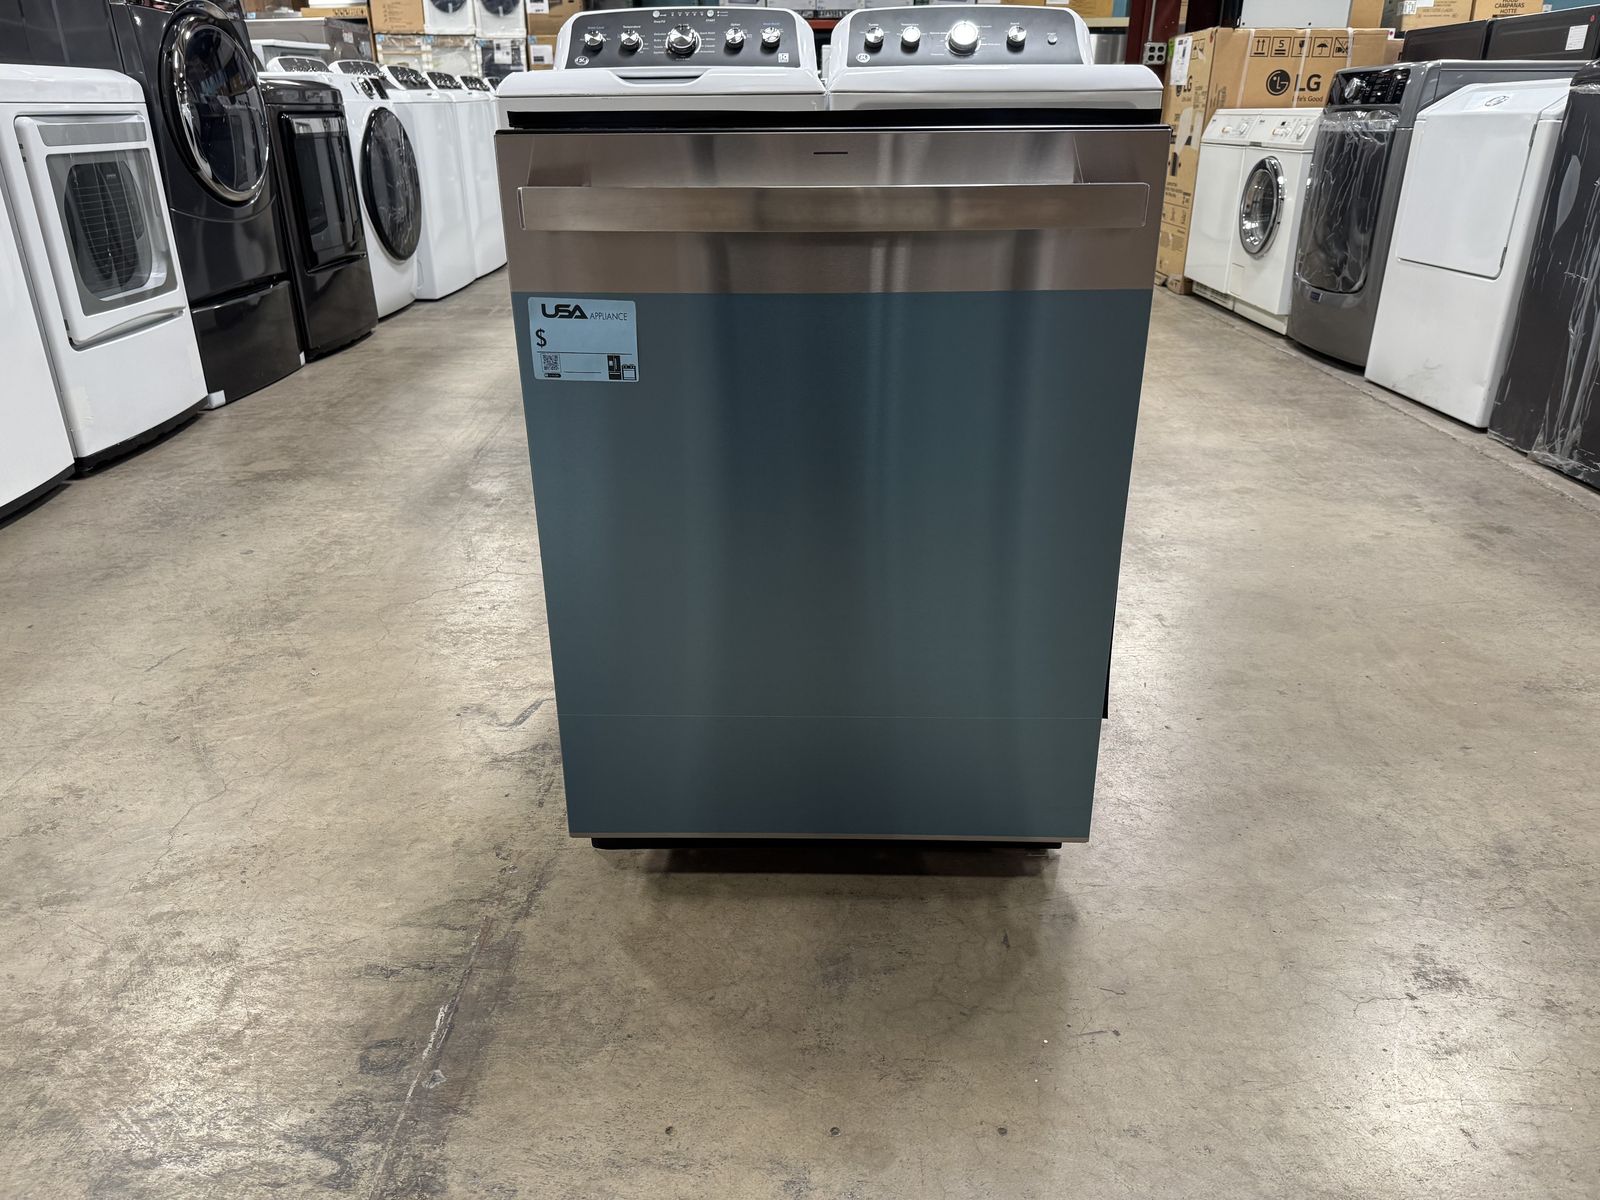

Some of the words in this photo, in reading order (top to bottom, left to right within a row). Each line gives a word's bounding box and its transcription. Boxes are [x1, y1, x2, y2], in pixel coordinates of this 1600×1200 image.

[1294, 74, 1321, 91] LG
[541, 304, 588, 319] USA
[590, 312, 627, 320] APPLIANCE
[535, 328, 547, 348] $
